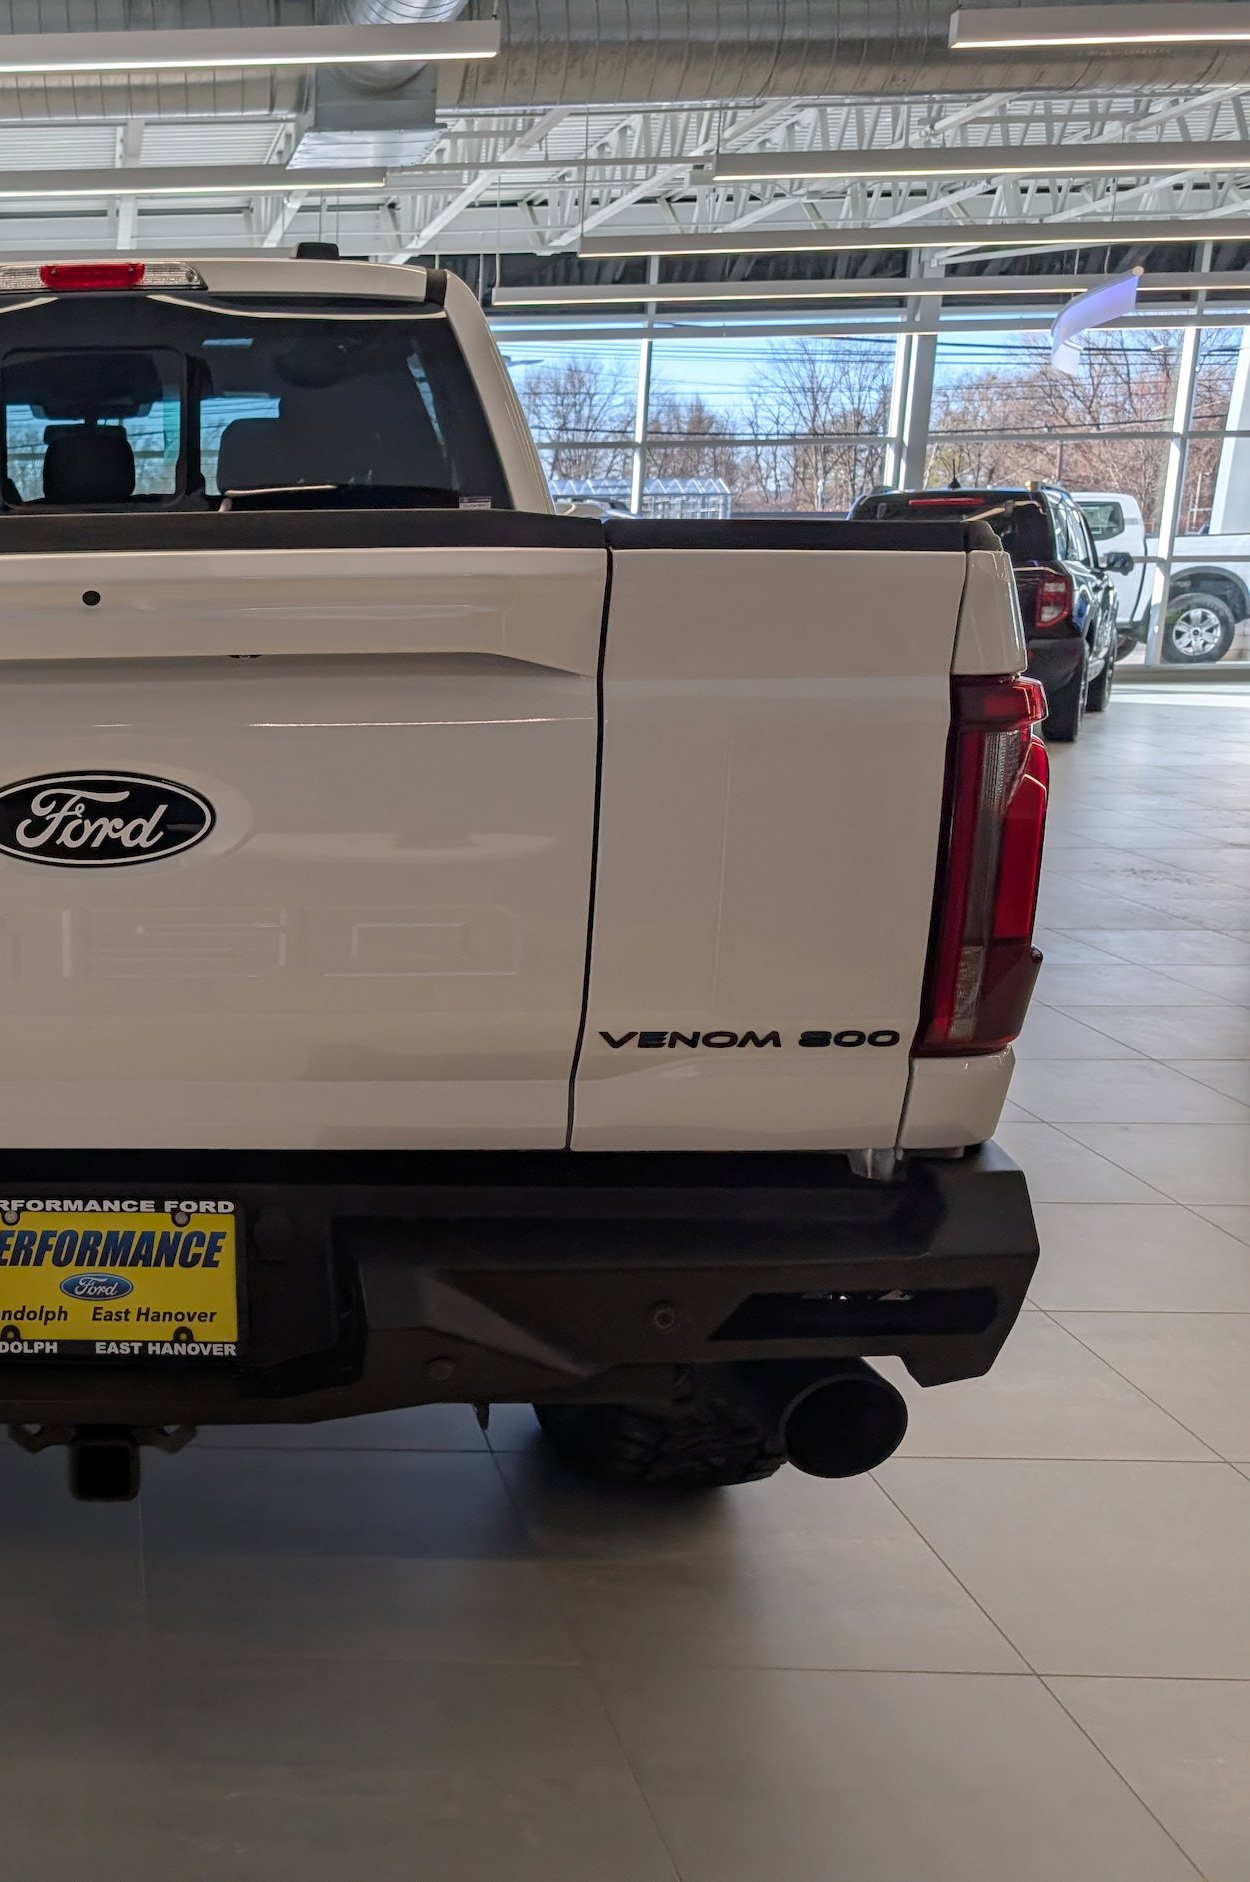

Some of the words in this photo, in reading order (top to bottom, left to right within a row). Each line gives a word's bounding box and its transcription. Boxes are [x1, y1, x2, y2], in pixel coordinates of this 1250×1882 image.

[16, 788, 168, 848] Ford
[598, 1030, 781, 1048] VENOM
[798, 1030, 900, 1047] 800
[164, 1200, 235, 1213] FORD
[74, 1275, 118, 1297] Ford
[92, 1307, 130, 1322] East
[136, 1307, 217, 1323] Hanover
[95, 1342, 142, 1355] EAST
[148, 1342, 237, 1356] HANOVER
